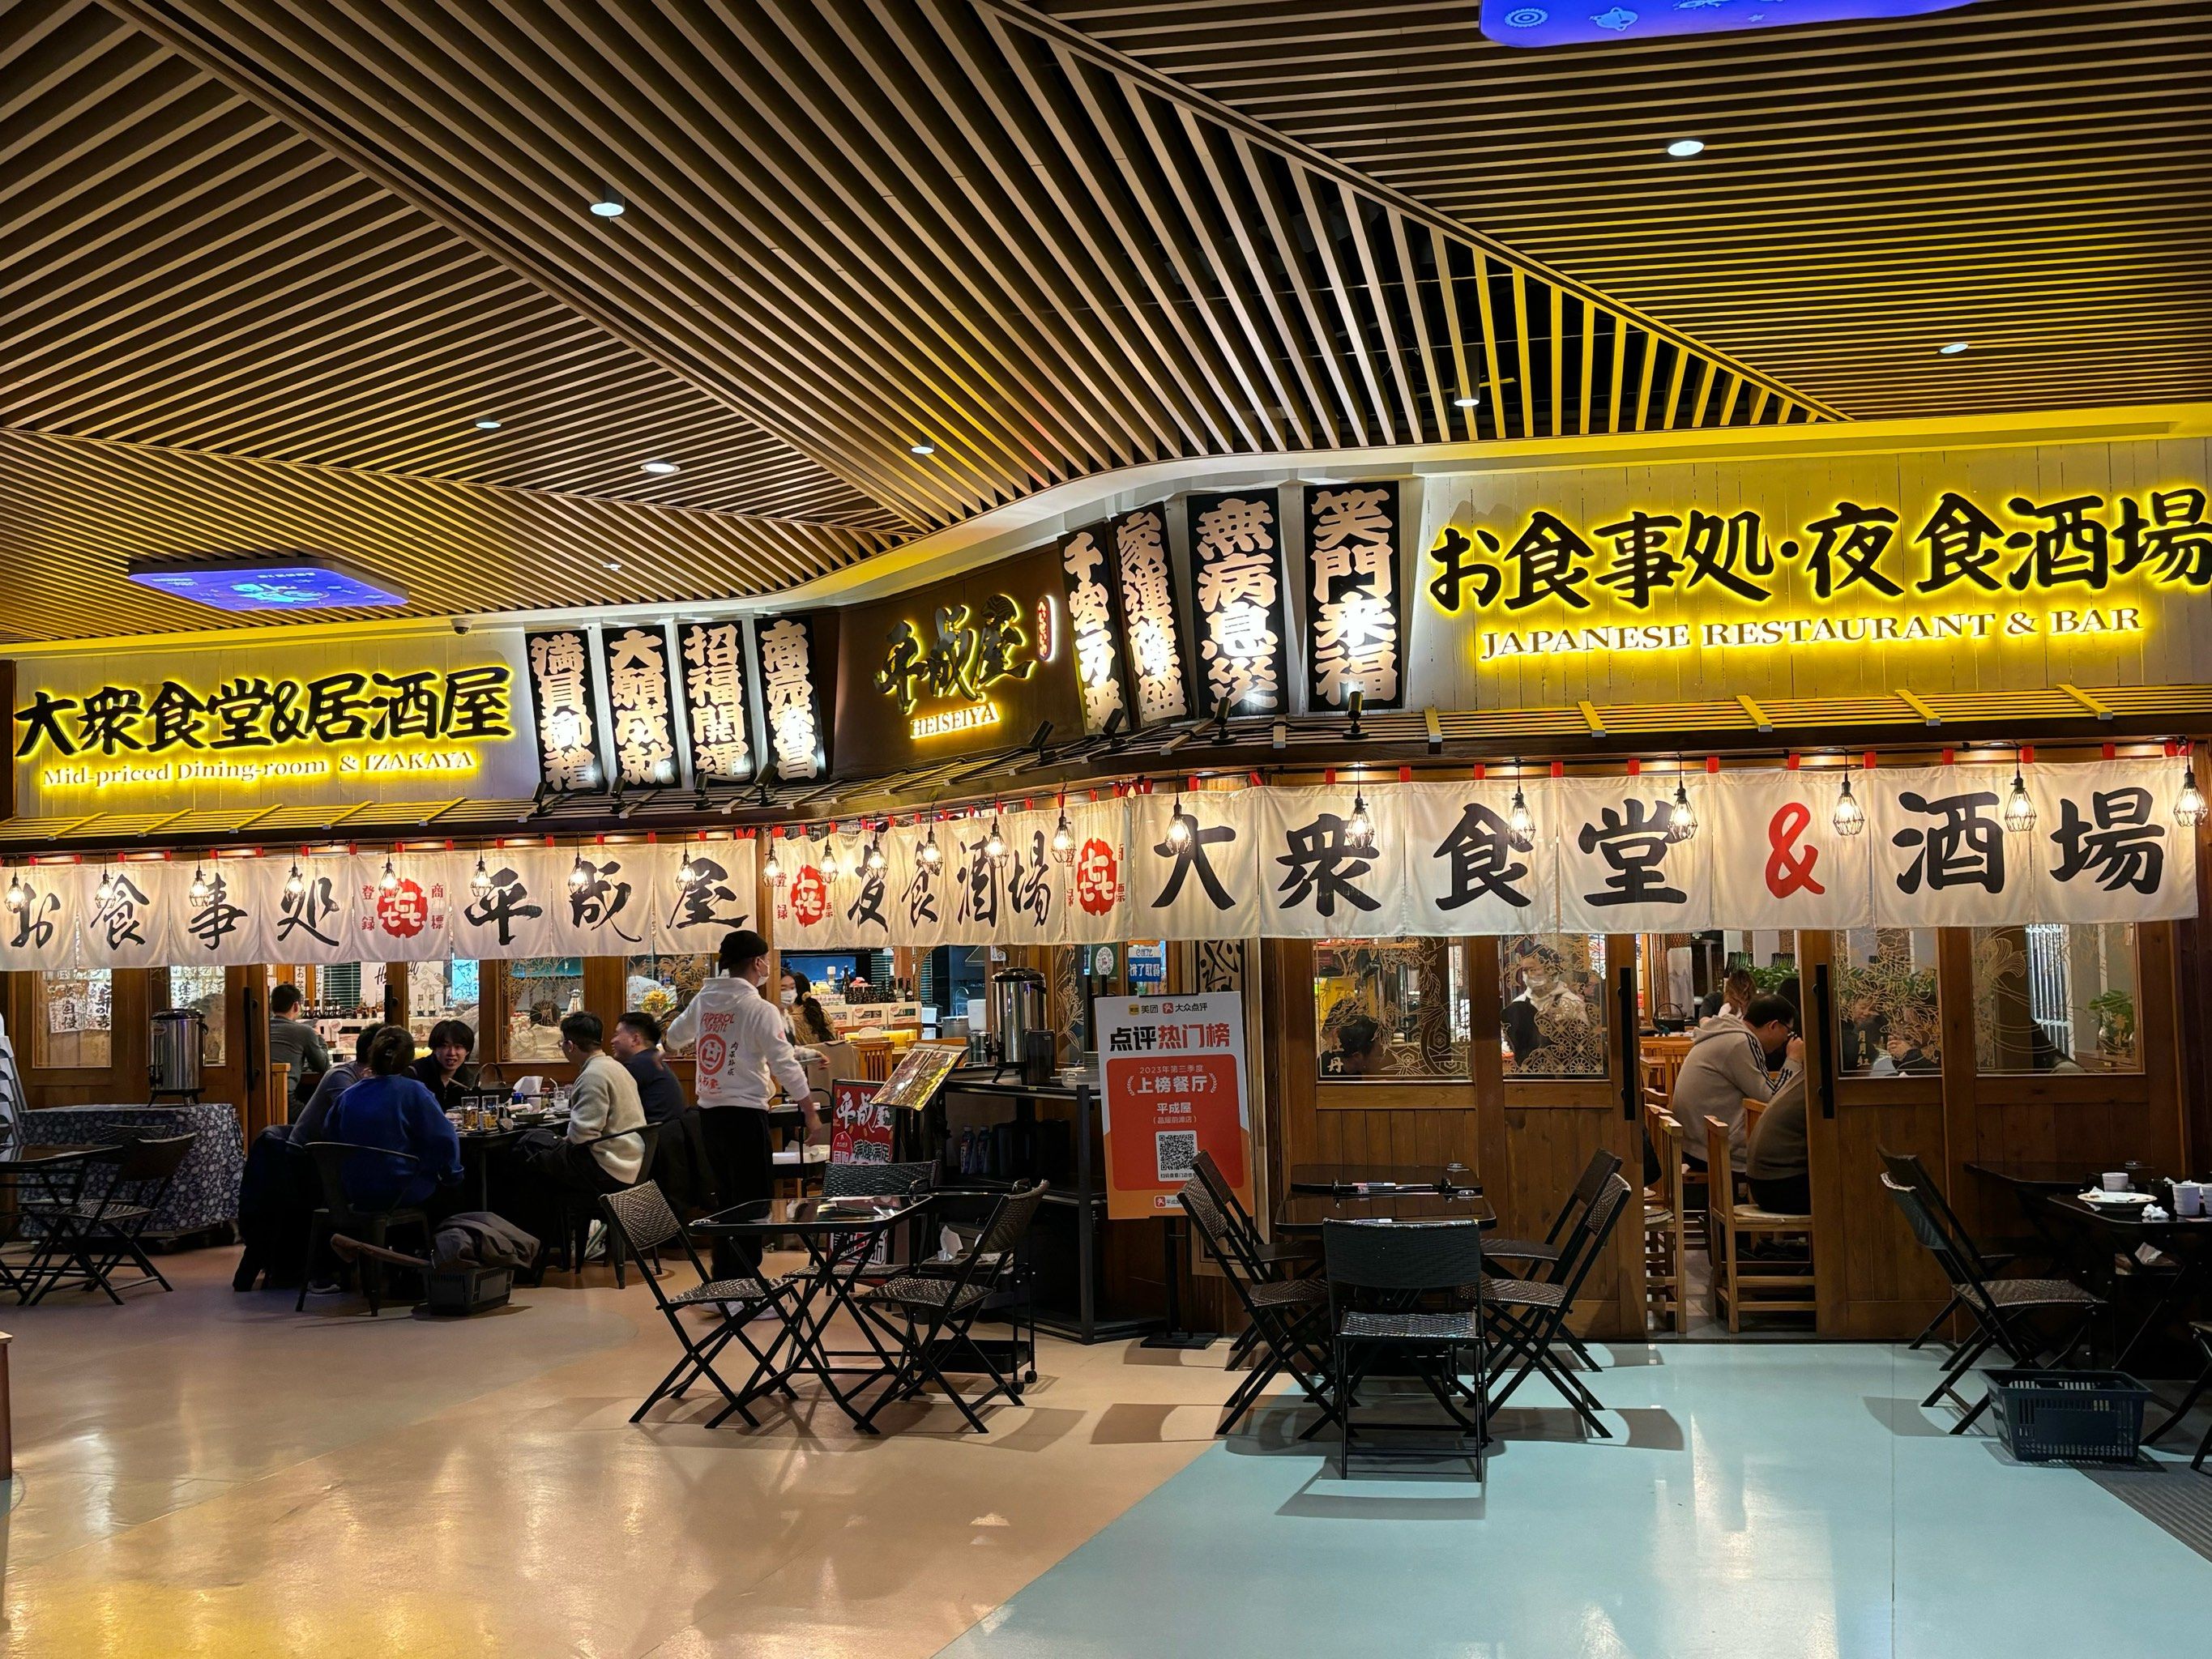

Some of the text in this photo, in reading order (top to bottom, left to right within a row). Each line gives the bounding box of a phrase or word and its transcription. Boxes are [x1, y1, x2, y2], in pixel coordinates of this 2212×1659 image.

[1197, 498, 1279, 710] 無病息災
[1311, 488, 1399, 706] 笑門来福
[1481, 608, 2144, 660] JAPANESE RESTAURANT & BAR
[15, 666, 514, 758] 大衆食堂&居酒屋
[609, 629, 676, 785] 大願成就
[683, 623, 750, 783] 招福開運
[911, 704, 999, 738] HEISEIYA
[43, 751, 474, 789] Mid-priced Dining-room & IZAKAYA
[1141, 1004, 1159, 1015] 美团
[1175, 1002, 1208, 1013] 大众点评
[1110, 1022, 1230, 1052] 点评热门榜
[1137, 1076, 1208, 1094] 上榜餐厅
[1139, 1064, 1205, 1074] 2023年第三季度
